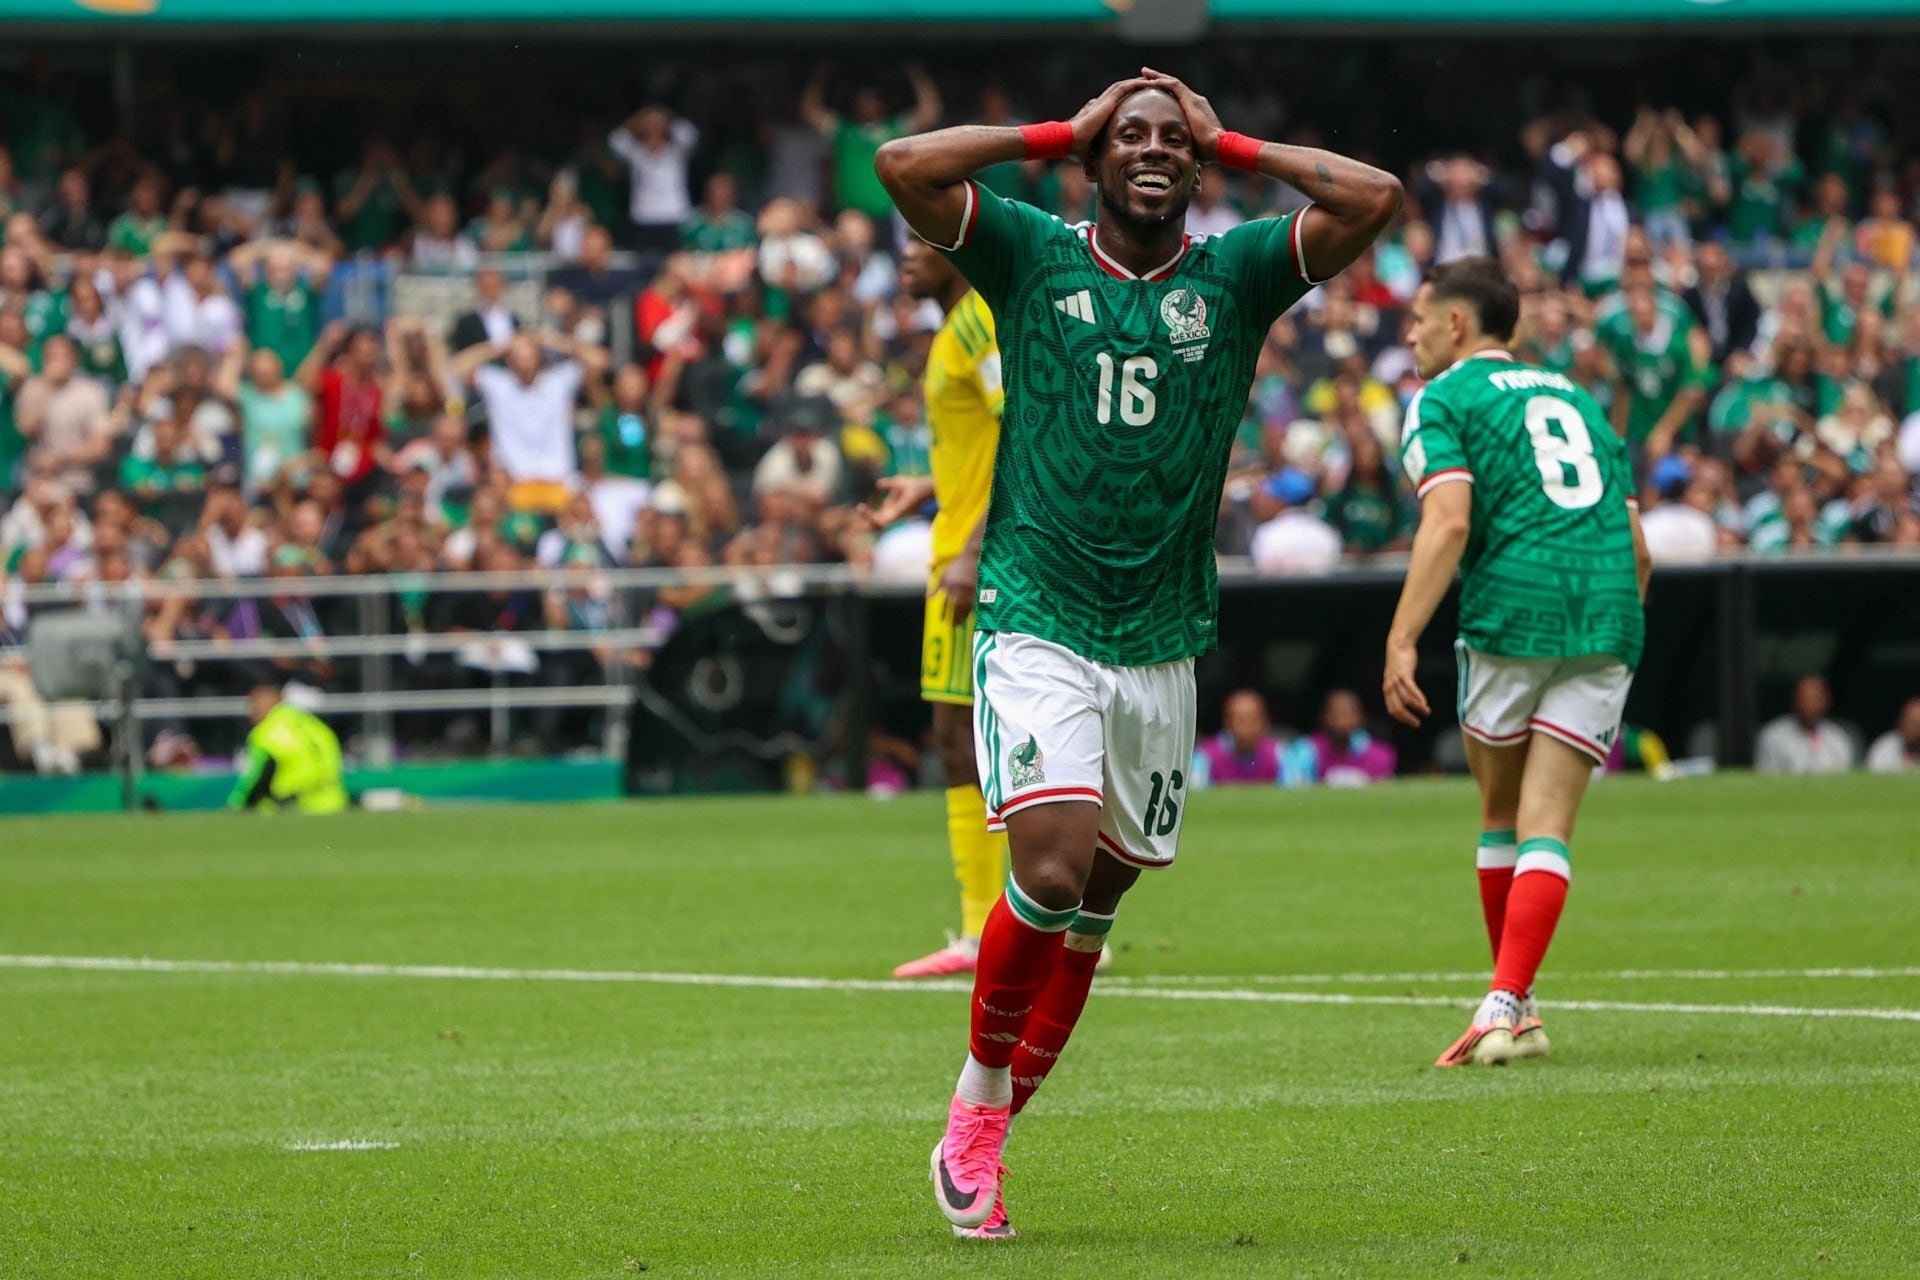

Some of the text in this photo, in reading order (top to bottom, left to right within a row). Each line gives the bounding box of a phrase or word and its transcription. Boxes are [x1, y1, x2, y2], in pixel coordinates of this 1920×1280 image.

[1096, 352, 1158, 427] 16
[1524, 395, 1604, 509] 8
[1144, 770, 1184, 837] 16
